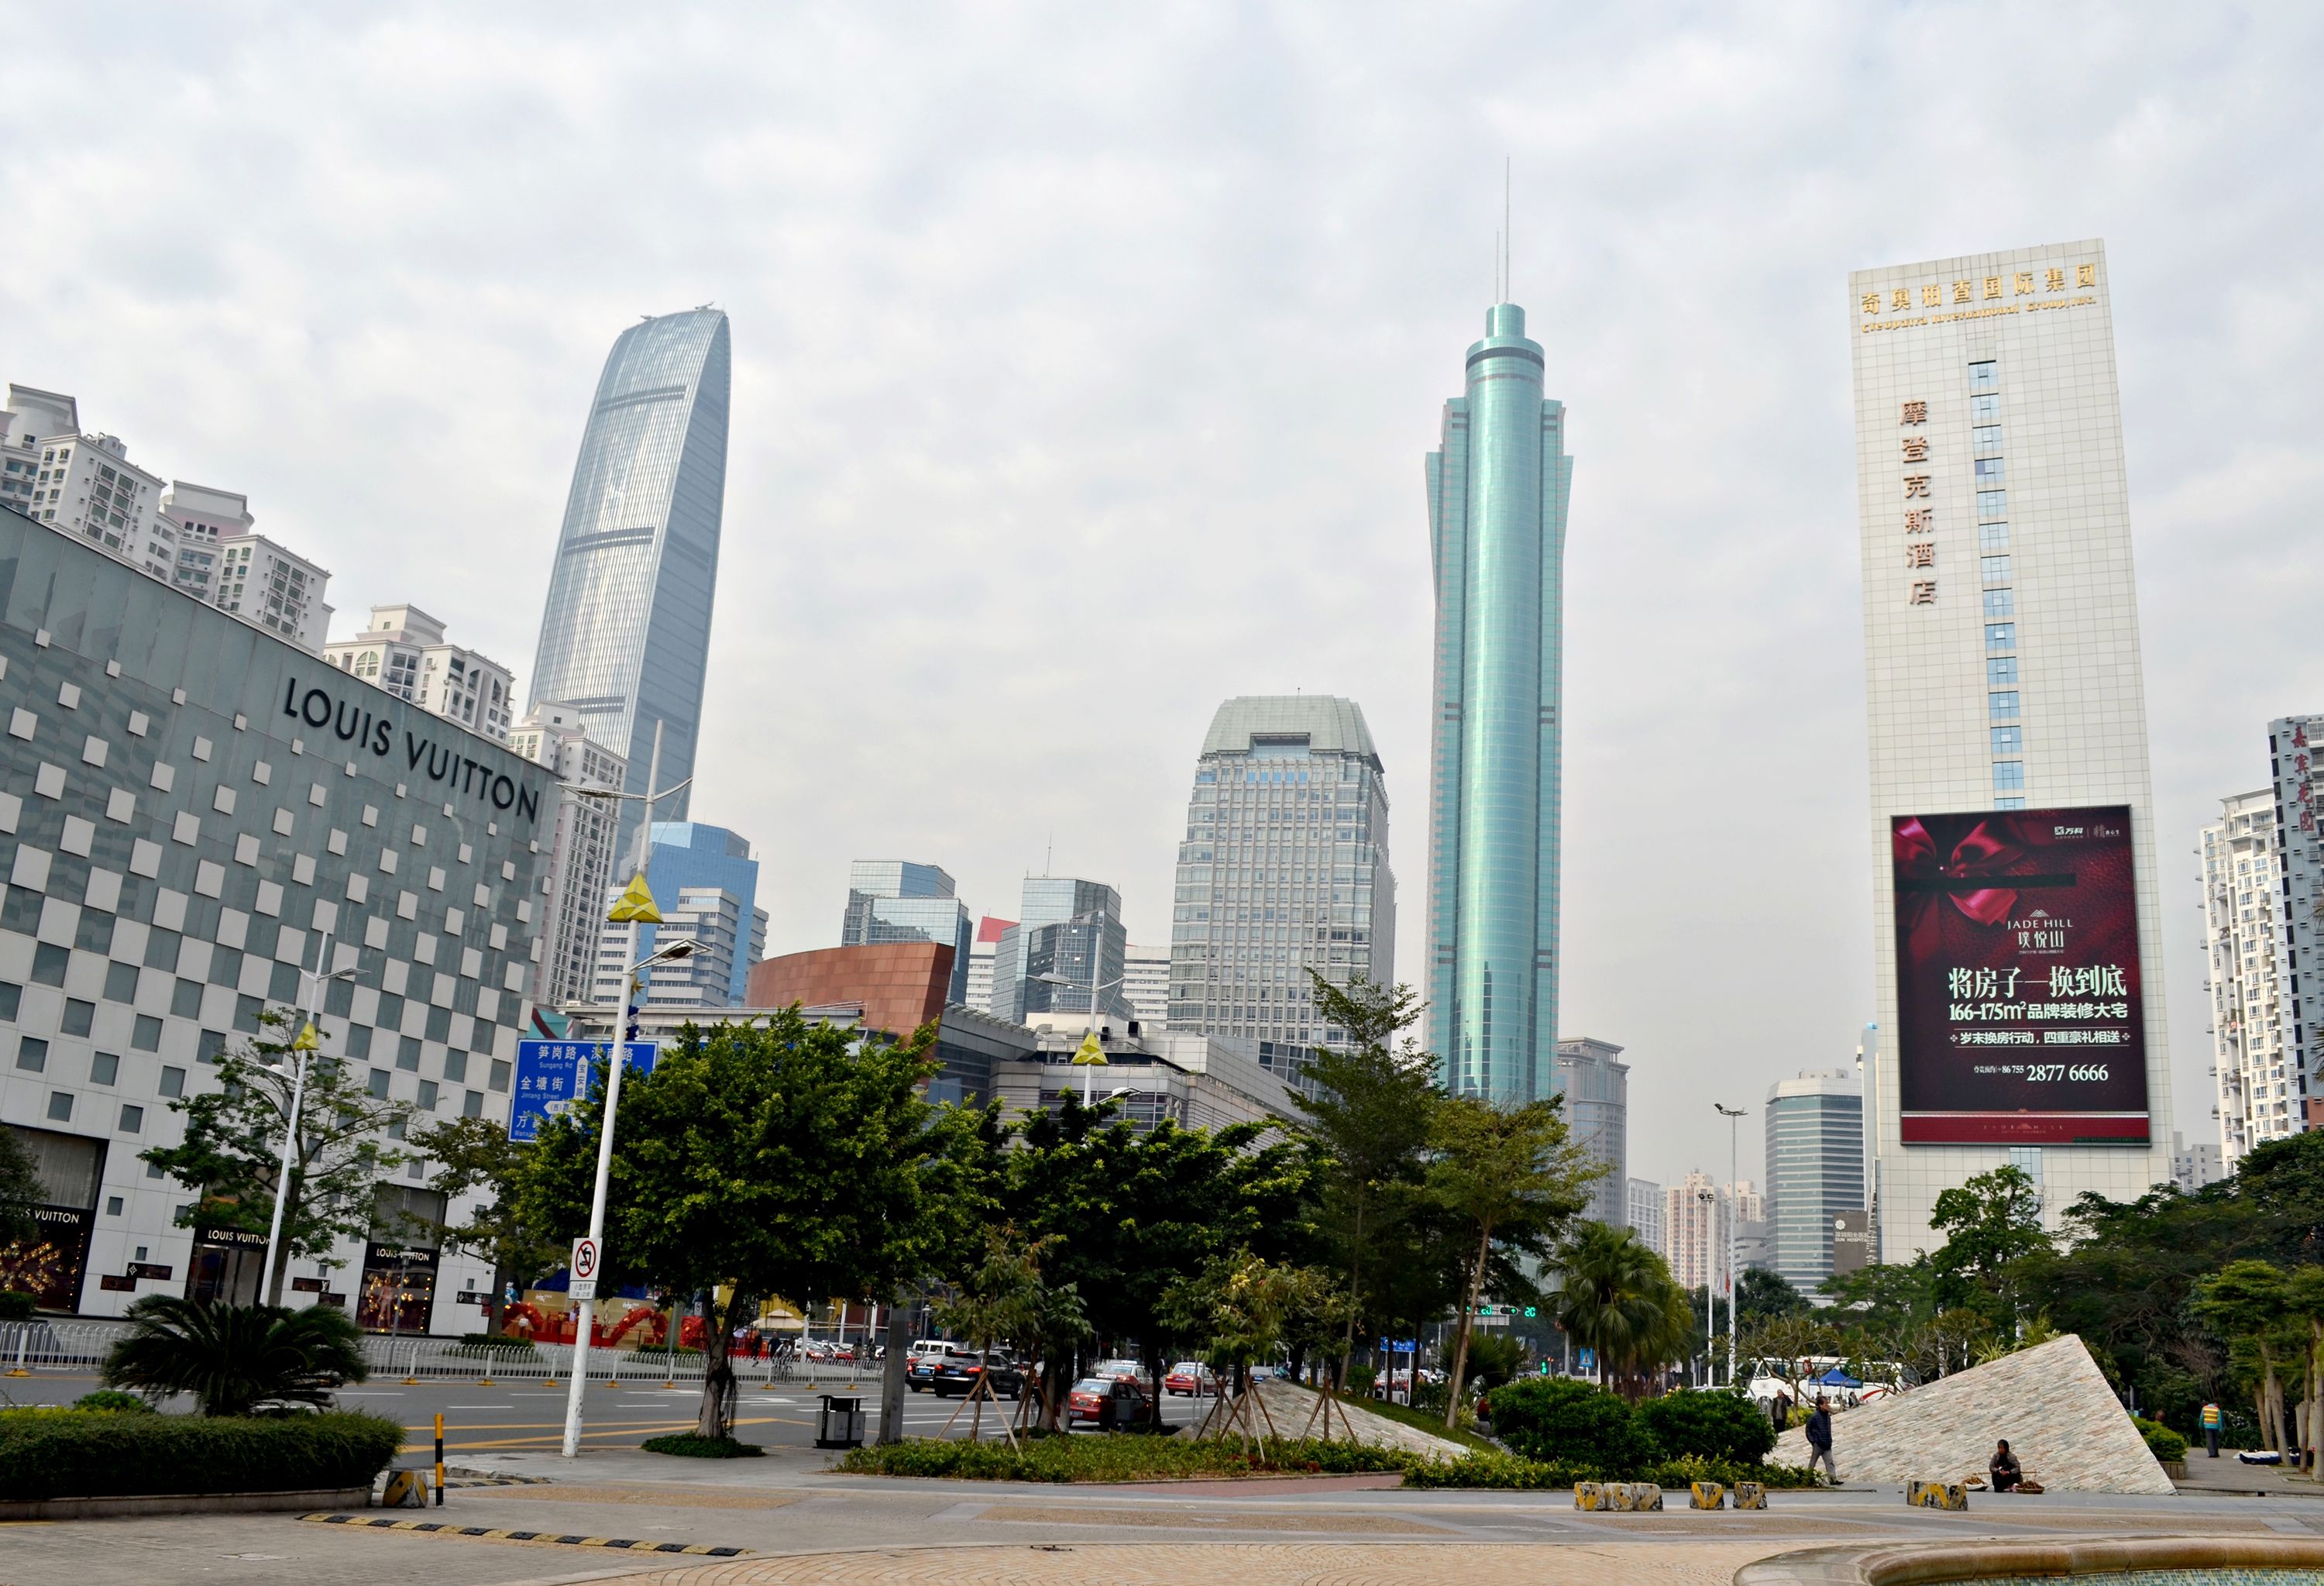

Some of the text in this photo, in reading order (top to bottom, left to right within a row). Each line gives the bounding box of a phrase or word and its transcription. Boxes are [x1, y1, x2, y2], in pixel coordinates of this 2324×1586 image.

[1862, 263, 2095, 315] 奇奥柏查国际集团
[1862, 316, 1927, 332] Cleopatra
[1932, 303, 2020, 323] International
[1899, 400, 1937, 605] 摩登克斯酒店
[284, 677, 539, 824] LOUIS VUITTON
[2007, 919, 2073, 930] JADE HILL
[1948, 965, 2127, 999] 将房子一换到底
[538, 1045, 576, 1060] 笋岗路
[521, 1075, 564, 1091] 金塘街
[576, 1065, 586, 1097] 宝安路
[2013, 1065, 2024, 1074] 755
[2027, 1065, 2065, 1081] 2877
[2069, 1064, 2109, 1081] 6666
[35, 1209, 80, 1223] VUITTON
[208, 1230, 234, 1241] LOUIS
